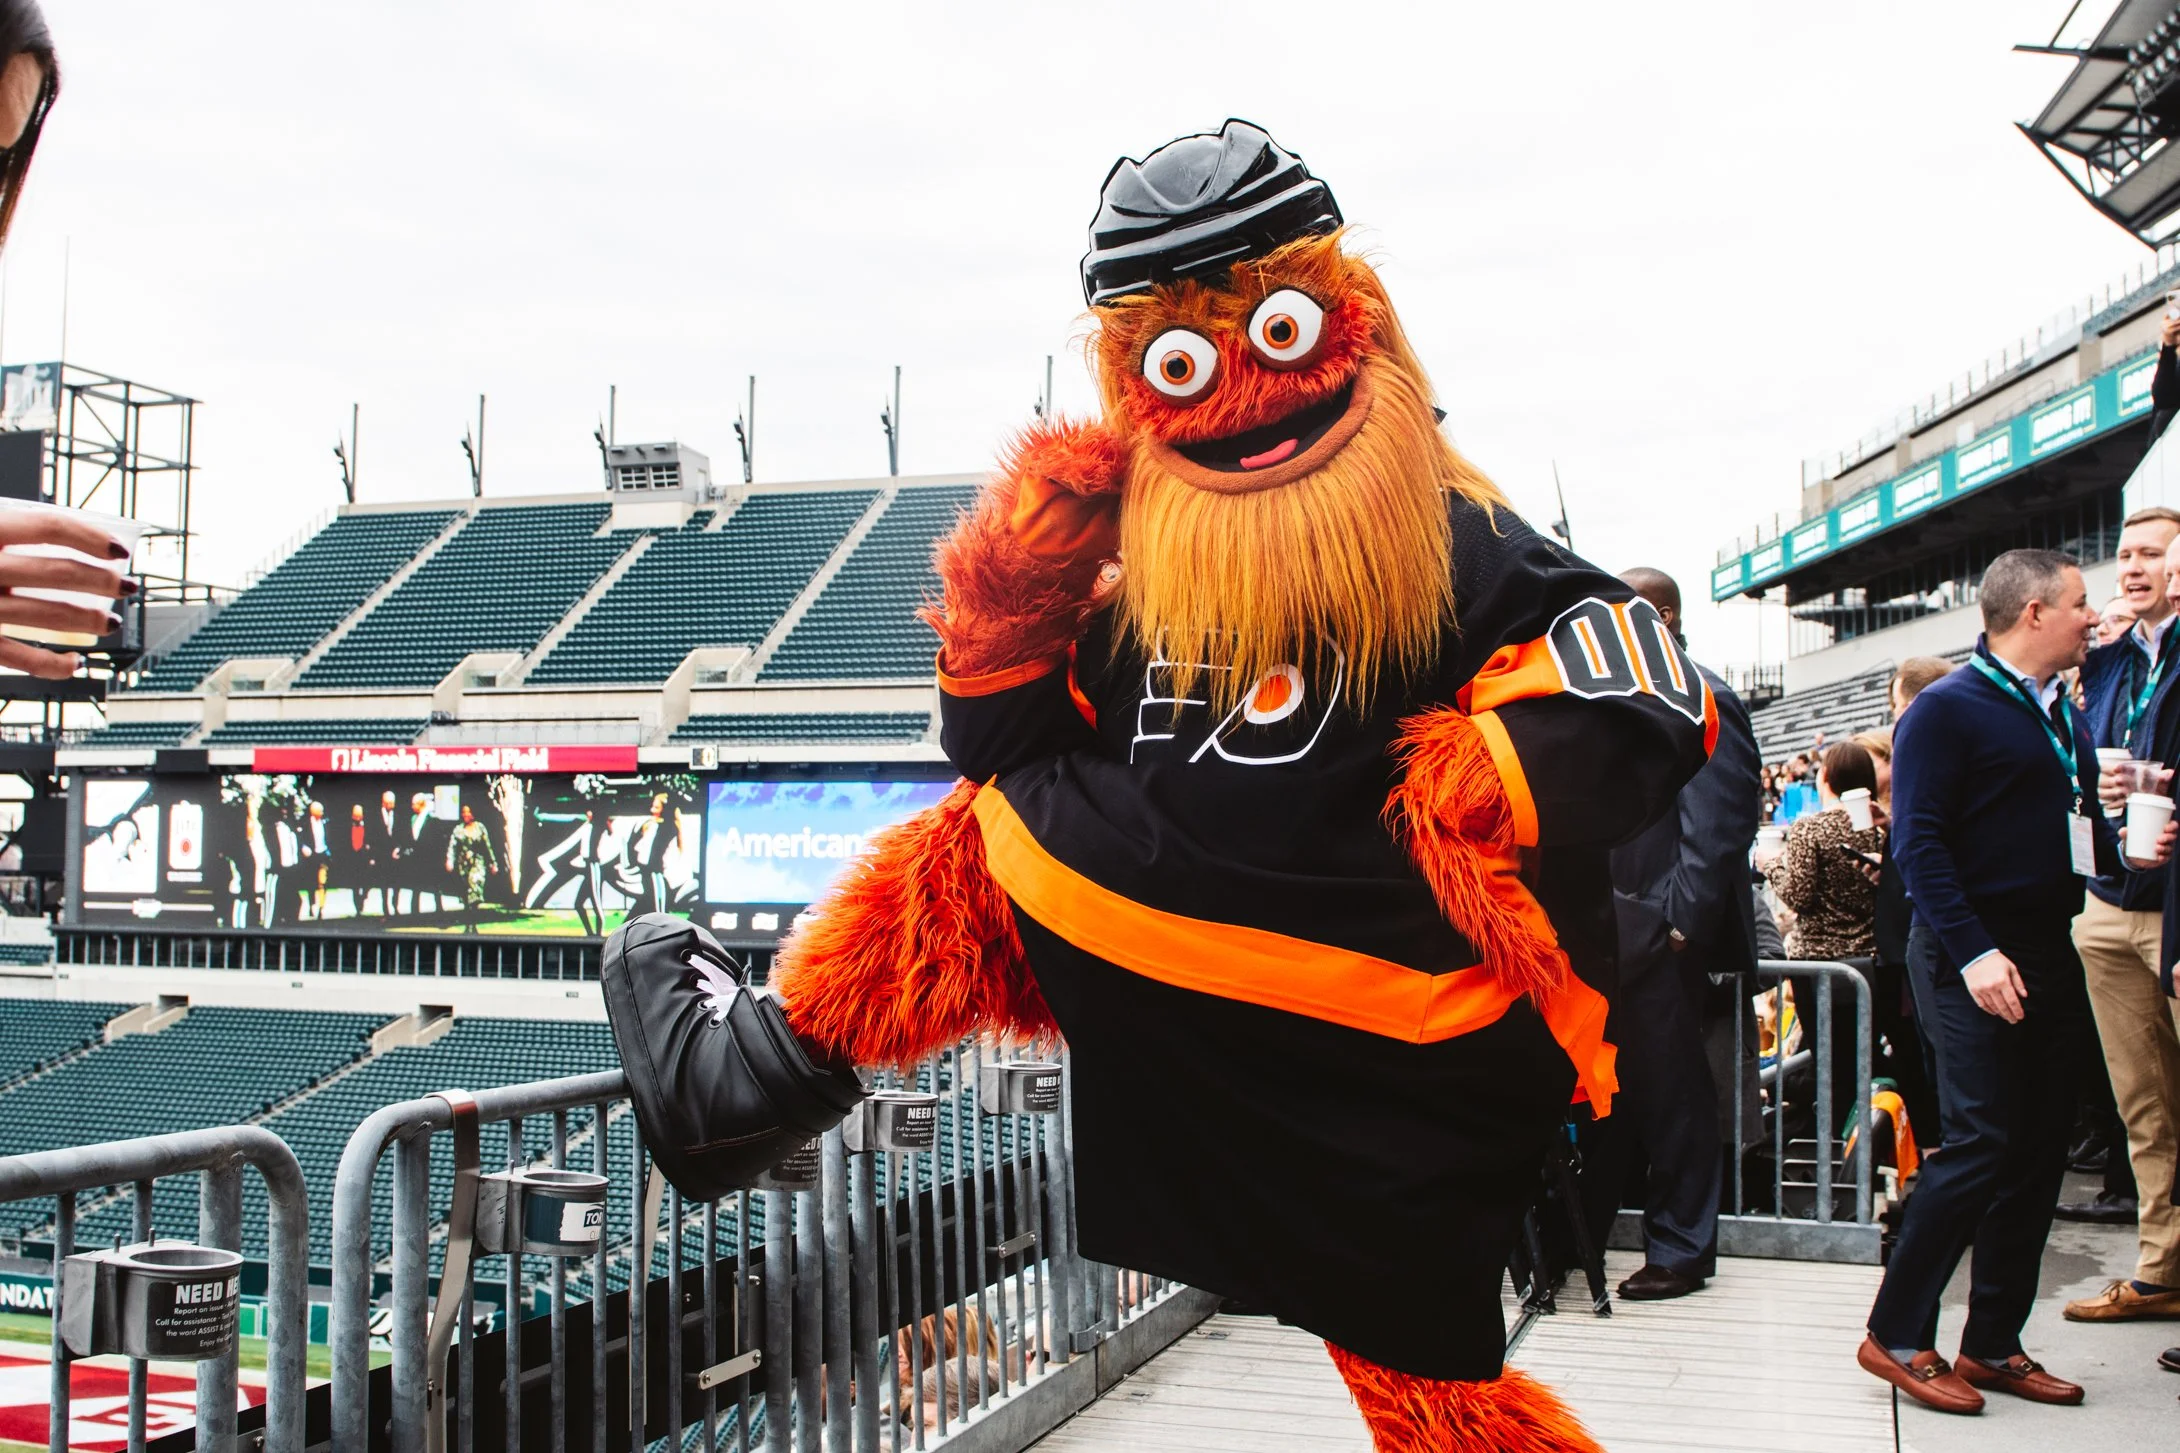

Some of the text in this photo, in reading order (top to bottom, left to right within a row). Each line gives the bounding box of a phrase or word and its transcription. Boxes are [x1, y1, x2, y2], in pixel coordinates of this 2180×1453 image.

[351, 748, 548, 771] Lincoln Financial Field
[722, 826, 864, 859] American
[1036, 1076, 1057, 1087] NEED
[907, 1107, 932, 1119] NEED
[175, 1282, 224, 1304] NEED
[173, 1306, 197, 1316] Report
[155, 1318, 170, 1326] Call
[184, 1316, 217, 1326] assistance
[166, 1329, 177, 1337] the
[179, 1328, 197, 1336] word
[198, 1325, 219, 1335] ASSIST
